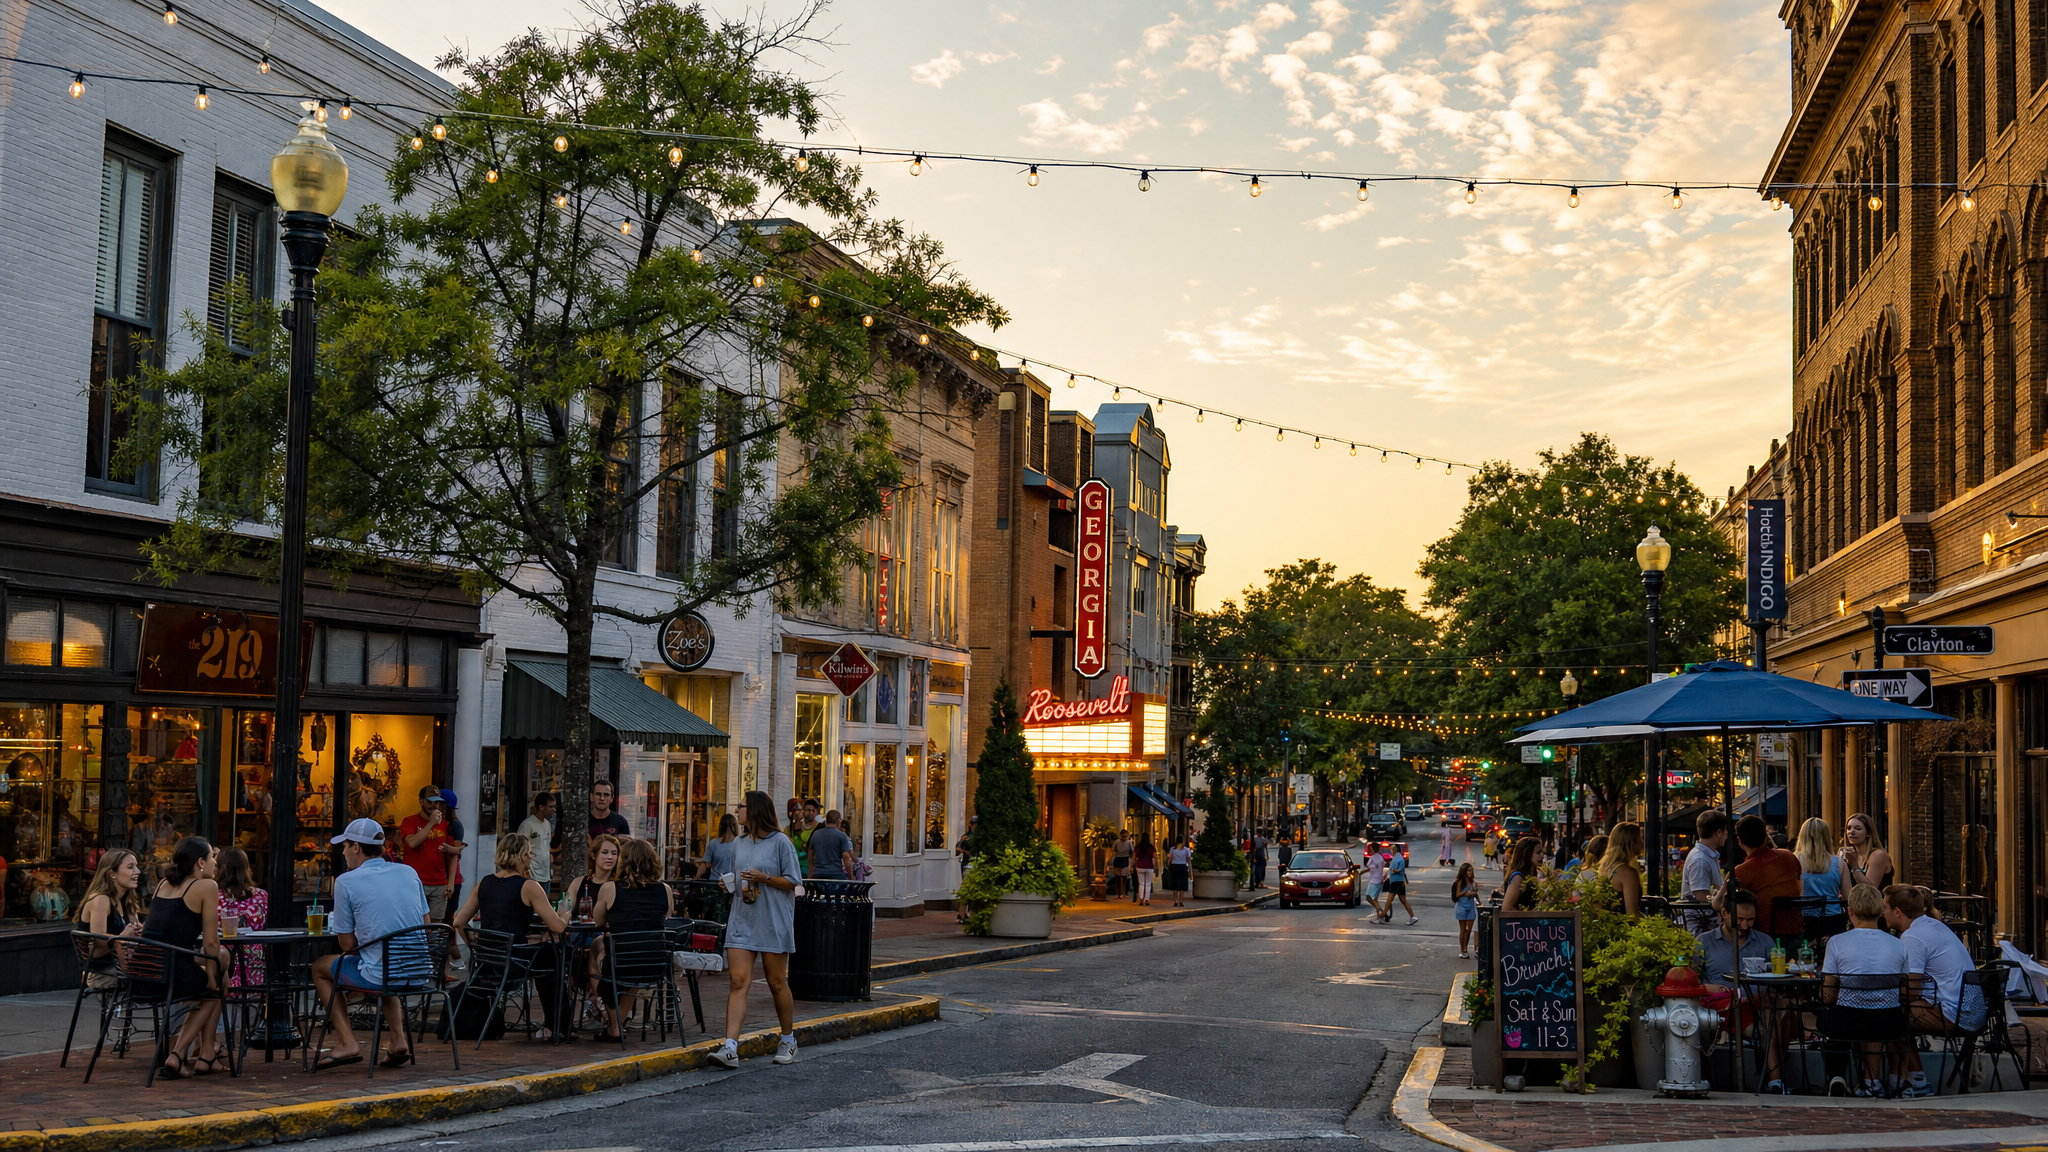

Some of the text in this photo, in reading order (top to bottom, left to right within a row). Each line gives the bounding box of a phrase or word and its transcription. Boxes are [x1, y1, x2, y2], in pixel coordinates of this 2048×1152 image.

[1079, 490, 1103, 665] GEORGIA
[1760, 549, 1774, 611] INDIGO
[666, 630, 706, 650] Zoe's
[1930, 628, 1938, 638] S
[196, 625, 263, 680] 219
[1906, 636, 1964, 654] Clayton
[828, 662, 869, 674] Kilwin's
[1022, 674, 1131, 723] Roosevelt
[1854, 680, 1907, 696] ONE WAY
[1505, 922, 1567, 942] JOIN US
[1526, 941, 1550, 954] FOR
[1500, 940, 1575, 987] Brunch!
[1507, 999, 1578, 1023] Sat & Sun
[1537, 1026, 1569, 1048] 11-3
